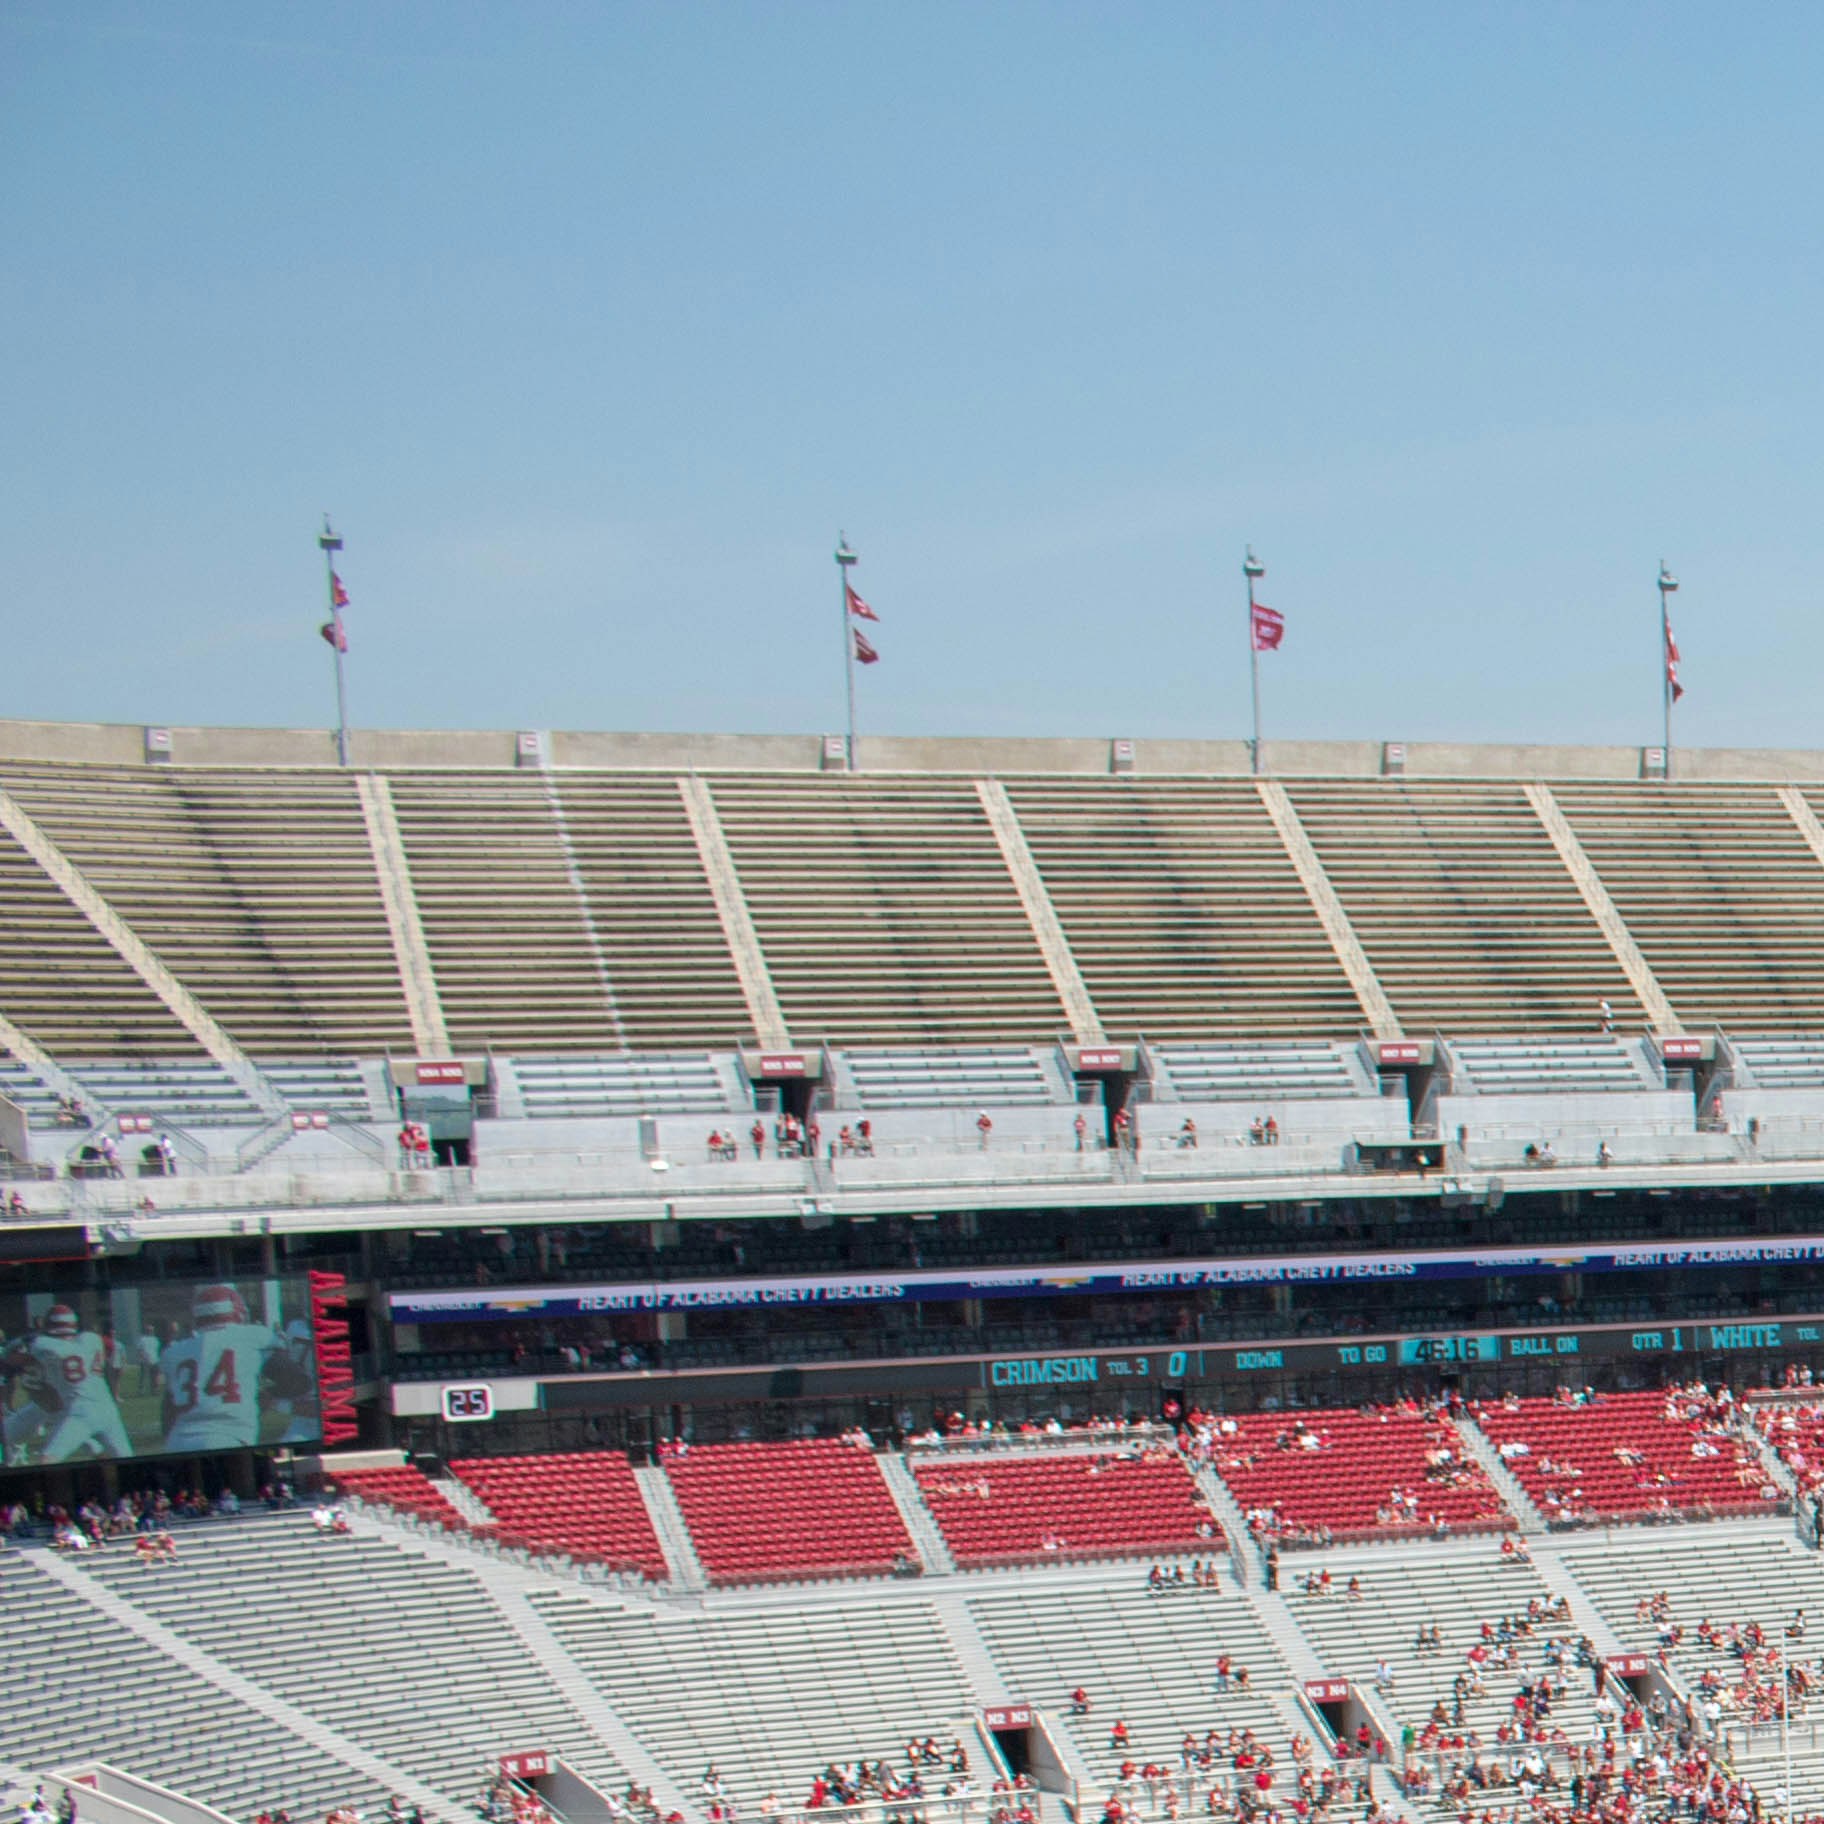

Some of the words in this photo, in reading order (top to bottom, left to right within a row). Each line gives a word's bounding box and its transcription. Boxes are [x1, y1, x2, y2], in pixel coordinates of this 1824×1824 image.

[1614, 1254, 1665, 1267] HEART
[1668, 1252, 1686, 1265] OF
[1689, 1247, 1762, 1263] ALABAMA
[1764, 1246, 1817, 1260] CHEVY
[1123, 1273, 1178, 1287] HEART
[1181, 1271, 1203, 1285] OF
[1205, 1267, 1282, 1283] ALABAMA
[1286, 1265, 1343, 1280] CHEVY
[1344, 1262, 1417, 1278] DEALERS
[579, 1294, 638, 1311] HEART
[643, 1293, 665, 1308] OF
[669, 1291, 758, 1306] ALABAMA
[762, 1287, 823, 1302] CHEVY
[826, 1284, 906, 1299] DEALERS
[1511, 1338, 1552, 1355] BALL
[1557, 1336, 1578, 1352] ON
[1632, 1333, 1663, 1350] QTR
[1672, 1328, 1683, 1351] 1
[1710, 1323, 1782, 1348] WHITE
[309, 1270, 358, 1446] ALABAMA
[1236, 1351, 1283, 1369] DOWN
[1339, 1347, 1360, 1364] TO
[1365, 1346, 1387, 1363] GO
[175, 1350, 241, 1411] 34
[992, 1357, 1098, 1387] CRIMSON
[1137, 1358, 1149, 1375] 3
[1169, 1350, 1188, 1377] 0
[451, 1390, 486, 1415] 25
